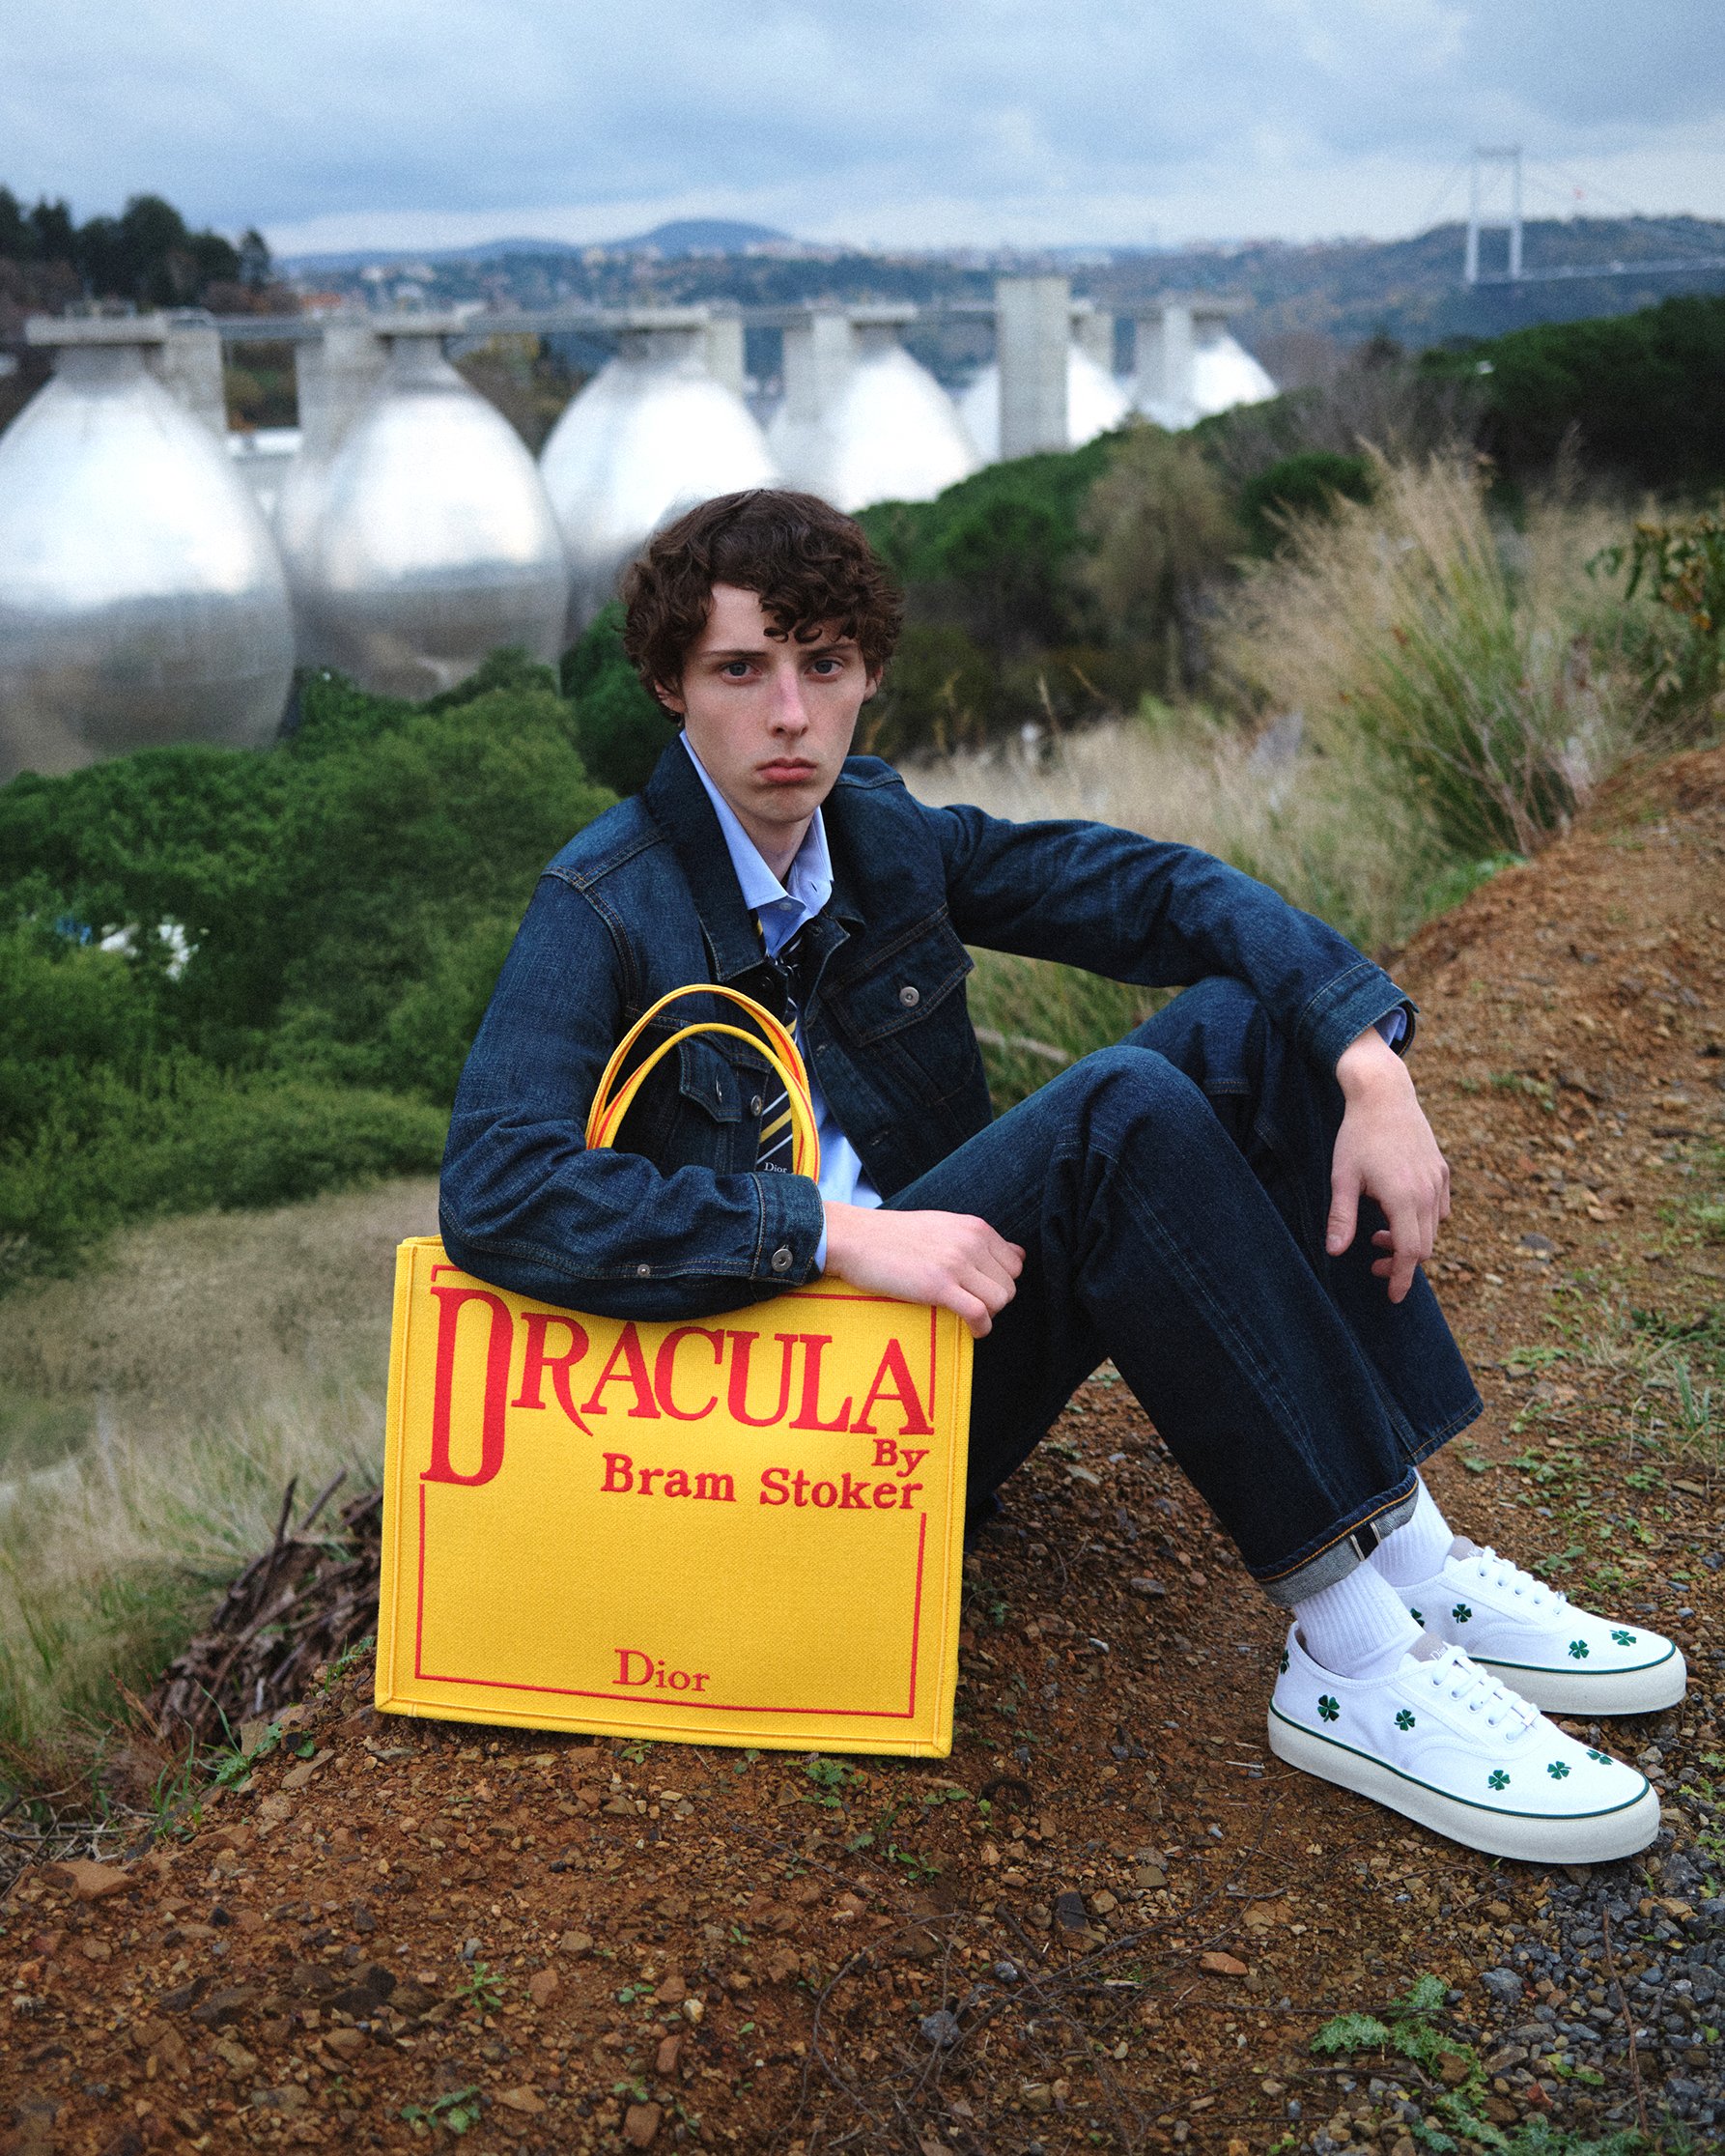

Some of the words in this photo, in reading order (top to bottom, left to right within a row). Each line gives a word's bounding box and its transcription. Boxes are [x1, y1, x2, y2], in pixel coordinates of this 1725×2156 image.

[764, 1162, 787, 1173] Dior
[419, 1286, 935, 1487] DRACULA
[870, 1438, 930, 1478] By
[600, 1452, 737, 1502] Bram
[759, 1467, 924, 1510] Stoker
[612, 1648, 711, 1692] Dior
